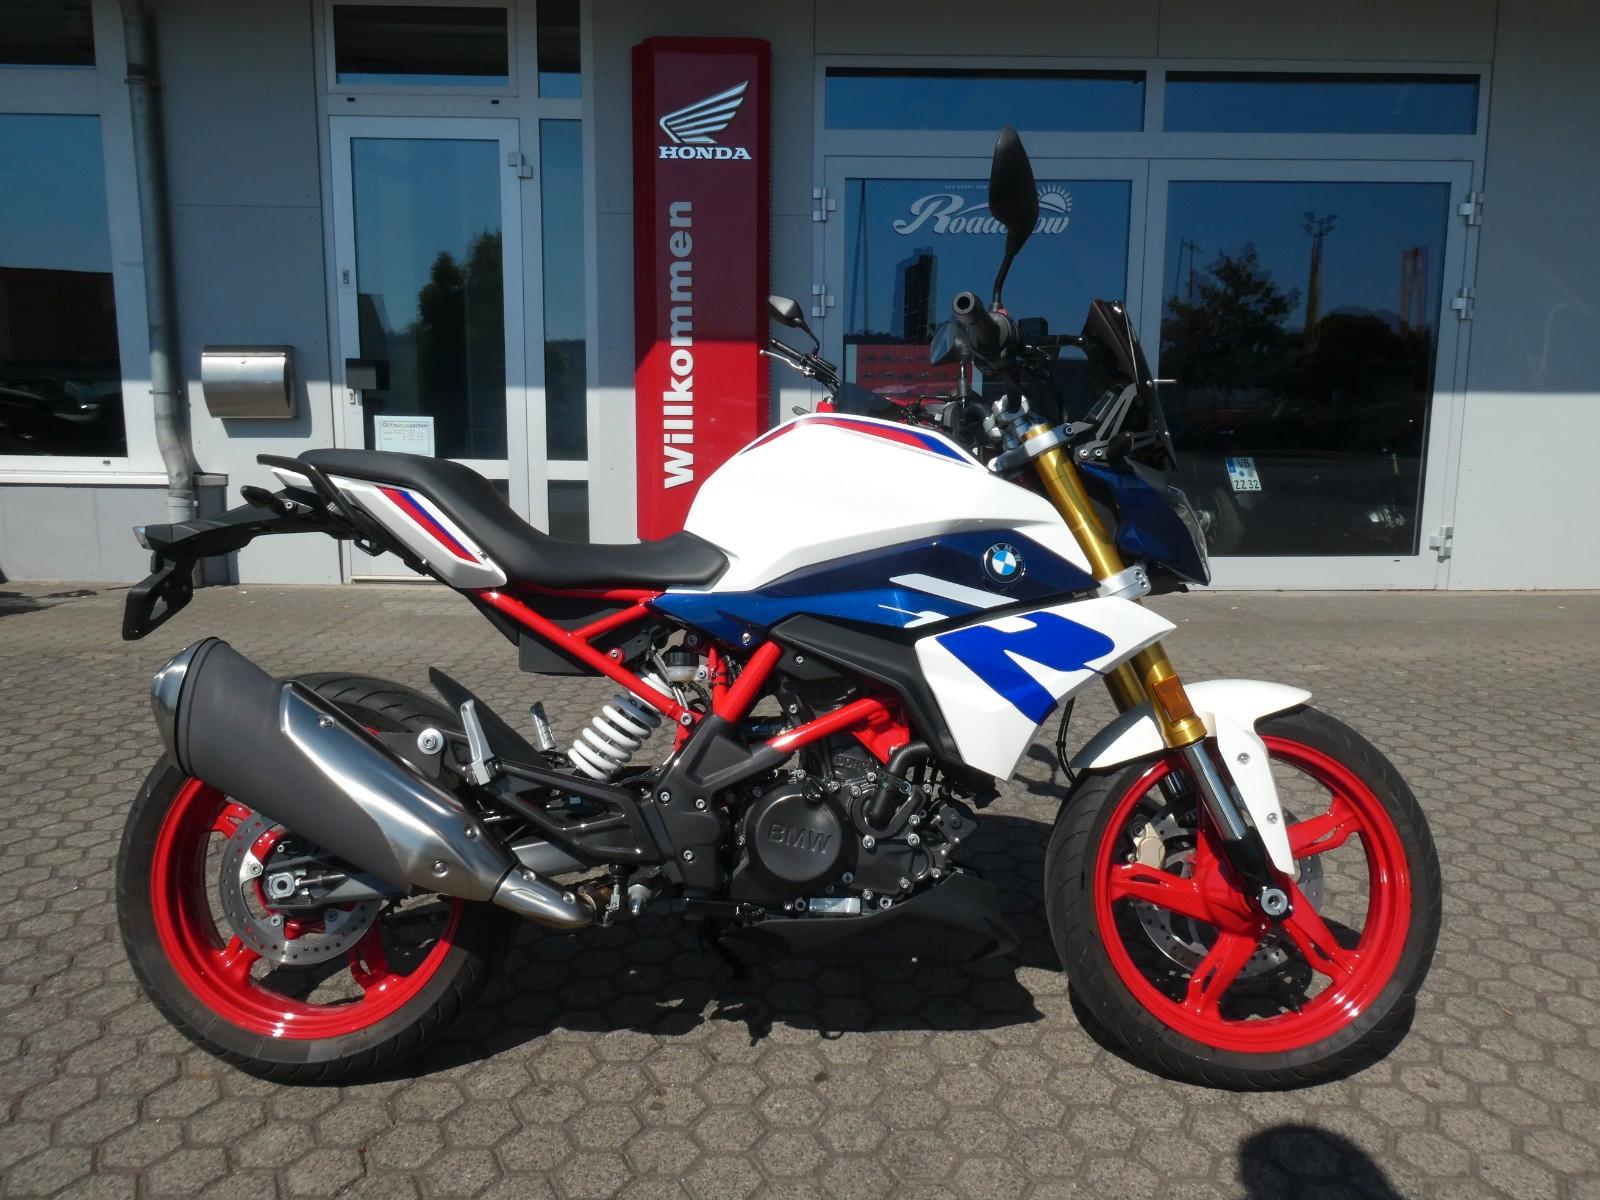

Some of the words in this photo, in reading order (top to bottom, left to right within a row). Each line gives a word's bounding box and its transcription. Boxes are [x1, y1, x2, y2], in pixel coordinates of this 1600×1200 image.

[659, 146, 752, 160] HONDA
[893, 193, 1070, 236] Roadow
[663, 201, 694, 489] Willkommen
[1247, 479, 1260, 489] 32
[991, 544, 1022, 562] BMW
[768, 824, 833, 855] BMW
